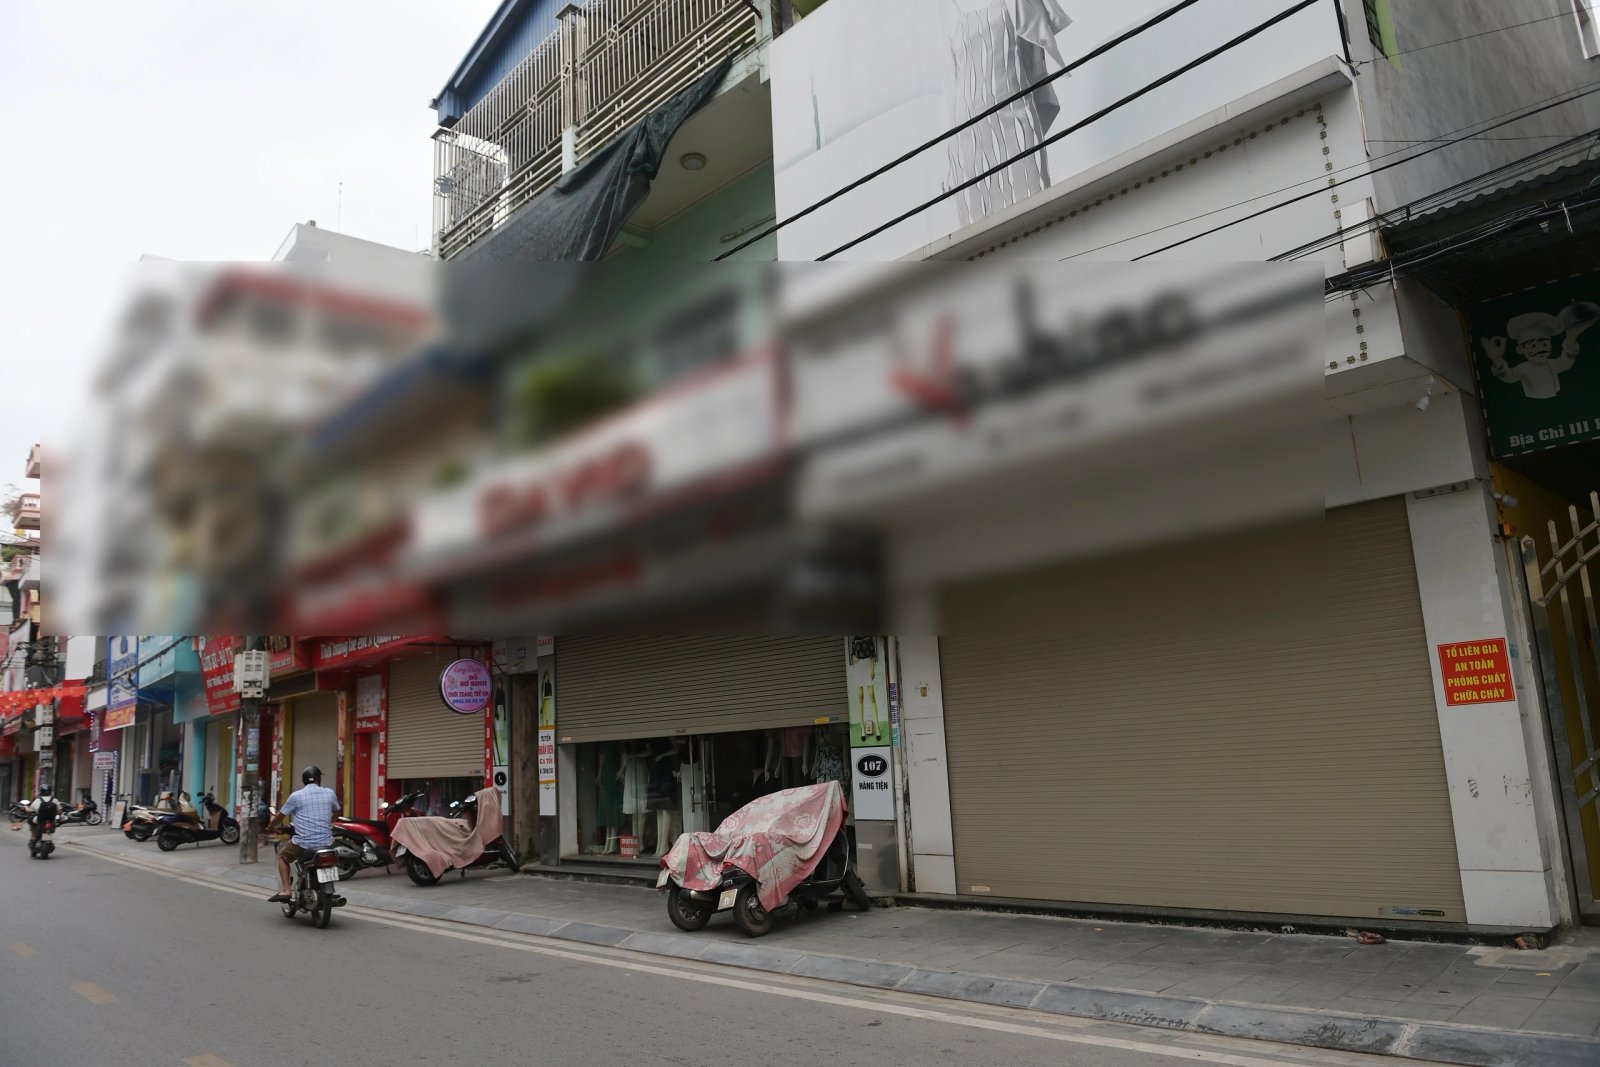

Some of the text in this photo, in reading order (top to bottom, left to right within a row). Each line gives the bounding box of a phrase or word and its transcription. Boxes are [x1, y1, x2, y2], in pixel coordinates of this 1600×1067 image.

[1509, 433, 1534, 448] Địa
[1538, 424, 1565, 441] Chỉ
[1459, 645, 1481, 657] LIÊN
[1482, 644, 1499, 654] GIA
[1455, 658, 1495, 672] AN TOÀN
[1448, 671, 1506, 687] PHÒNG CHÁY
[1453, 687, 1505, 701] CHỮA CHÁY
[863, 760, 882, 771] 107
[859, 780, 888, 792] HÀNG TIỆN
